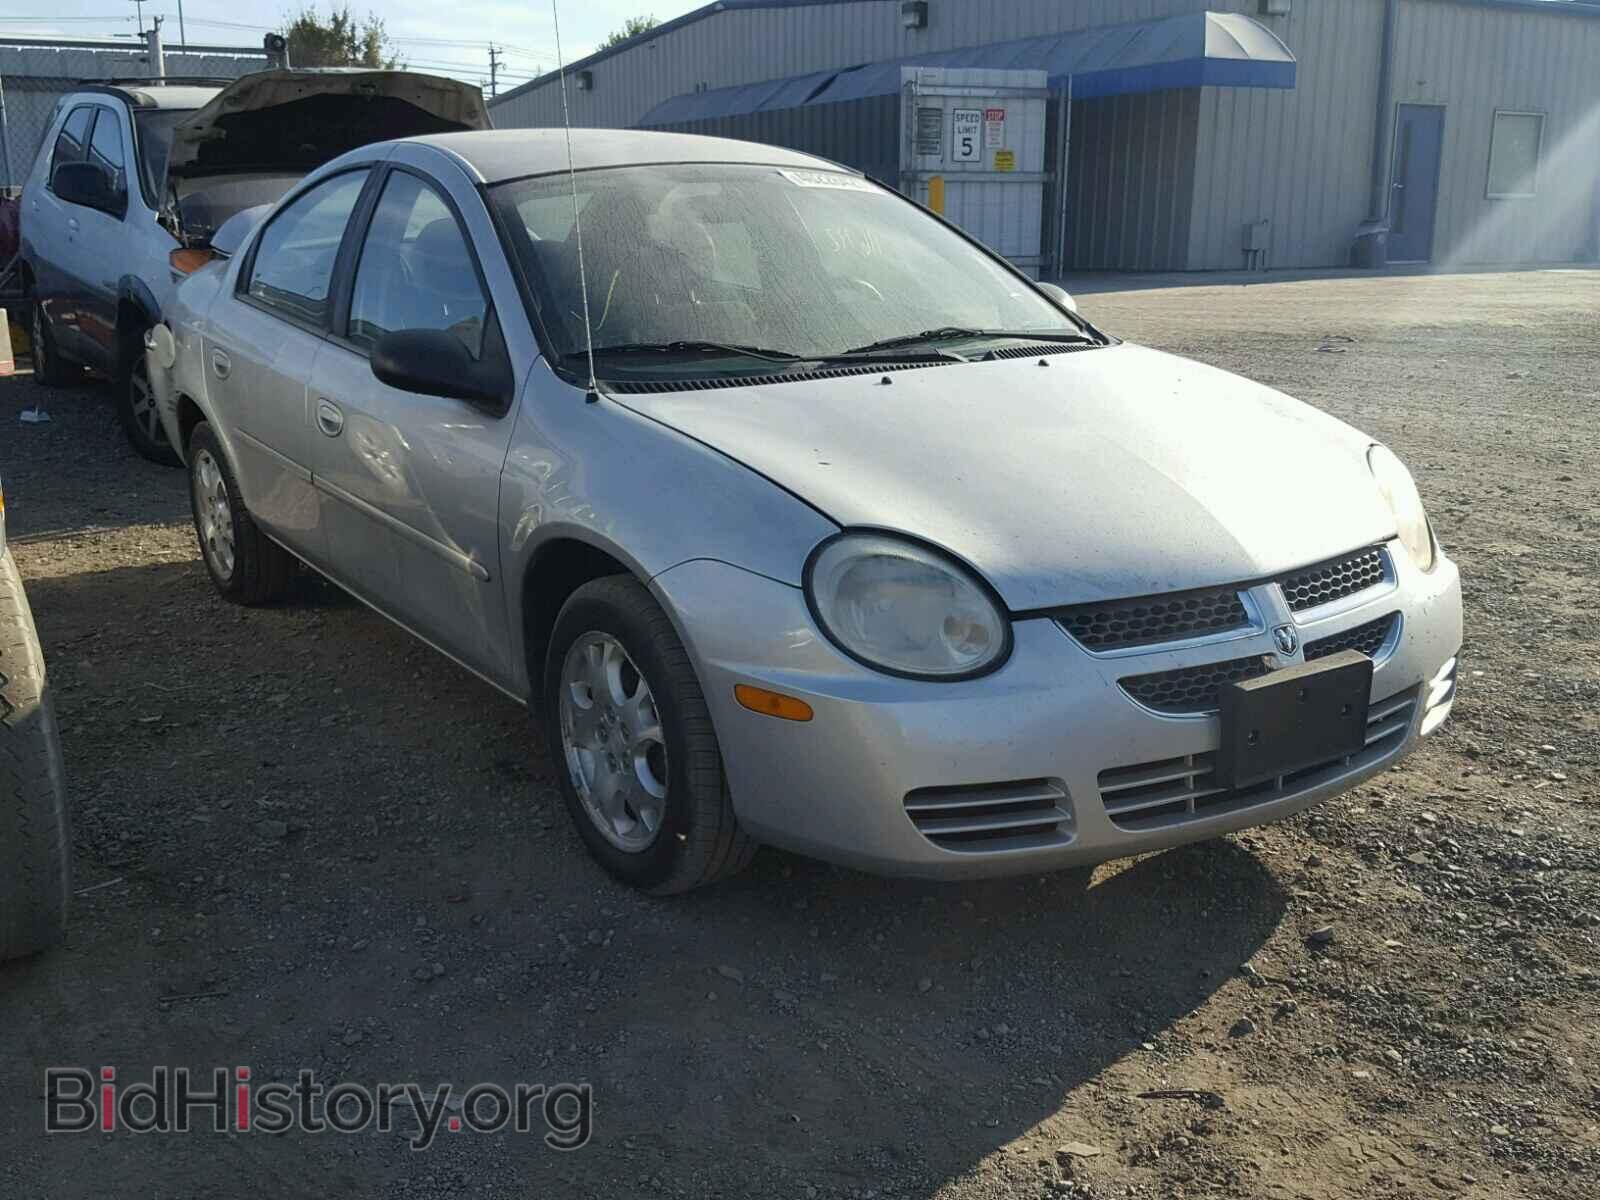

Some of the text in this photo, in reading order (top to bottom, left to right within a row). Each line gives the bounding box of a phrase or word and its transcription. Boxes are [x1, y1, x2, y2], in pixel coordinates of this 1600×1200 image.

[955, 112, 980, 123] SPEED
[988, 111, 1003, 120] STOP
[957, 126, 977, 135] LIMIT
[961, 137, 973, 156] 5
